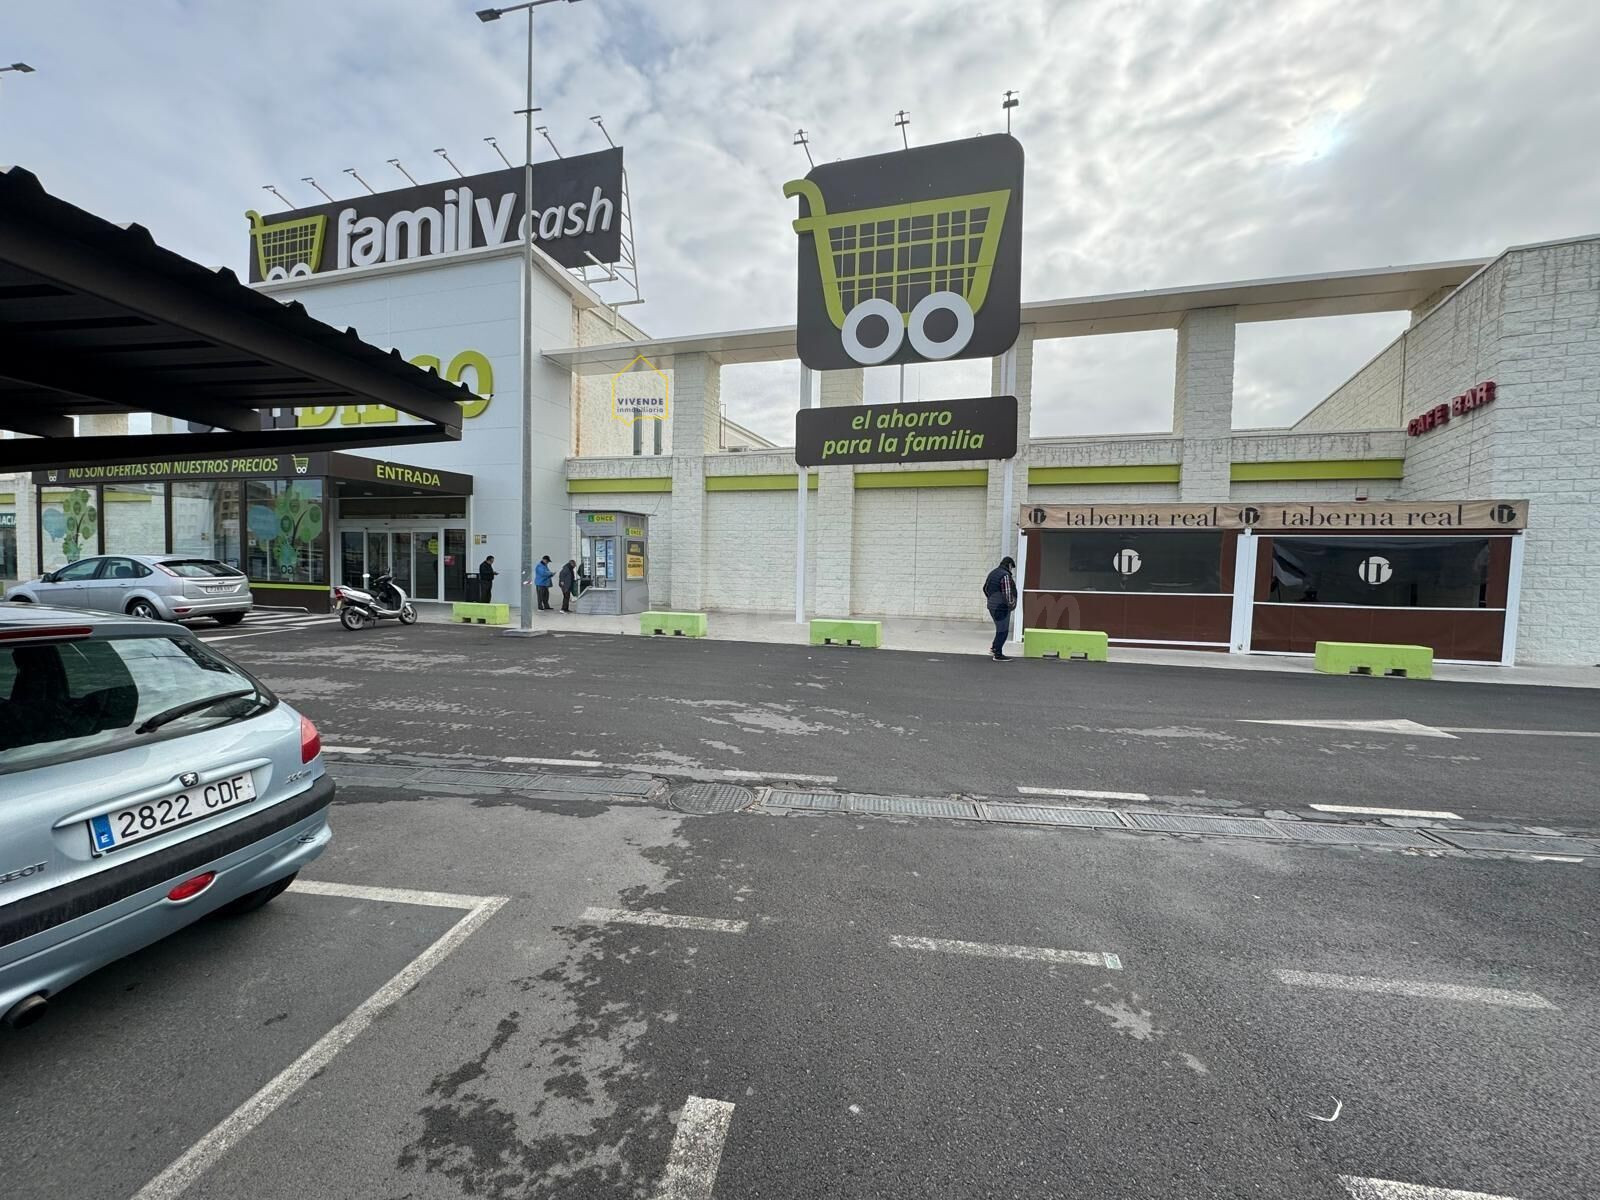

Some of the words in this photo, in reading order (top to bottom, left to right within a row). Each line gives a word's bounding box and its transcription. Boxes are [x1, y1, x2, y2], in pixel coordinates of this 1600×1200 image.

[518, 186, 613, 243] cash
[851, 410, 872, 430] el
[876, 409, 953, 430] ahorro
[1407, 403, 1450, 437] CAFE
[1451, 381, 1496, 417] BAR
[822, 436, 872, 459] para
[877, 433, 898, 453] la
[900, 429, 985, 457] familia
[84, 466, 105, 478] SON
[106, 463, 148, 477] OFERTAS
[149, 462, 172, 475] SON
[173, 460, 229, 474] NUESTROS
[231, 458, 279, 472] PRECIOS
[376, 464, 441, 487] ENTRADA
[1066, 507, 1161, 527] taberna
[1170, 506, 1217, 527] real
[1282, 506, 1394, 527] taberna
[1407, 505, 1464, 526] real
[117, 794, 193, 839] 2822
[203, 776, 244, 809] CDF
